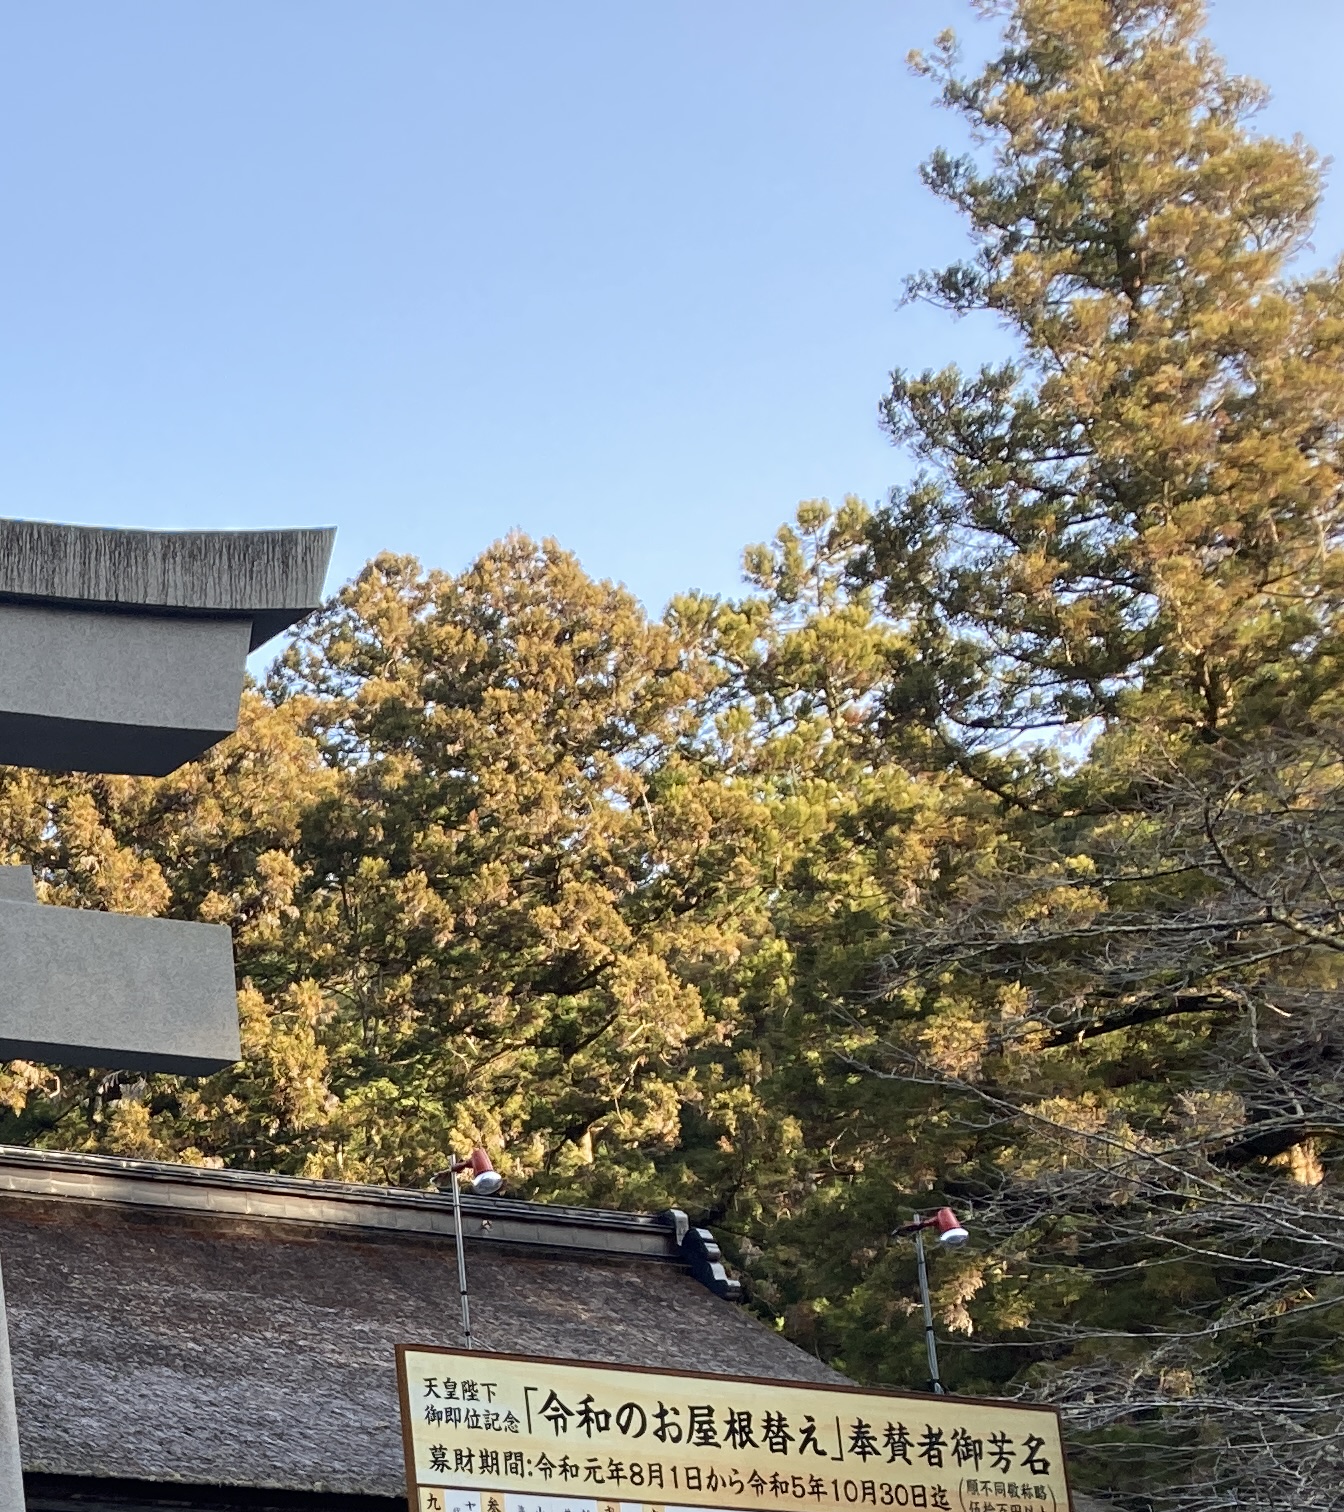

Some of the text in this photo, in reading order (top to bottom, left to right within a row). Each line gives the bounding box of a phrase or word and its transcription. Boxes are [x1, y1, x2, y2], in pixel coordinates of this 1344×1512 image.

[423, 1377, 497, 1403] 天皇陛下
[425, 1405, 520, 1433] 御即位記念
